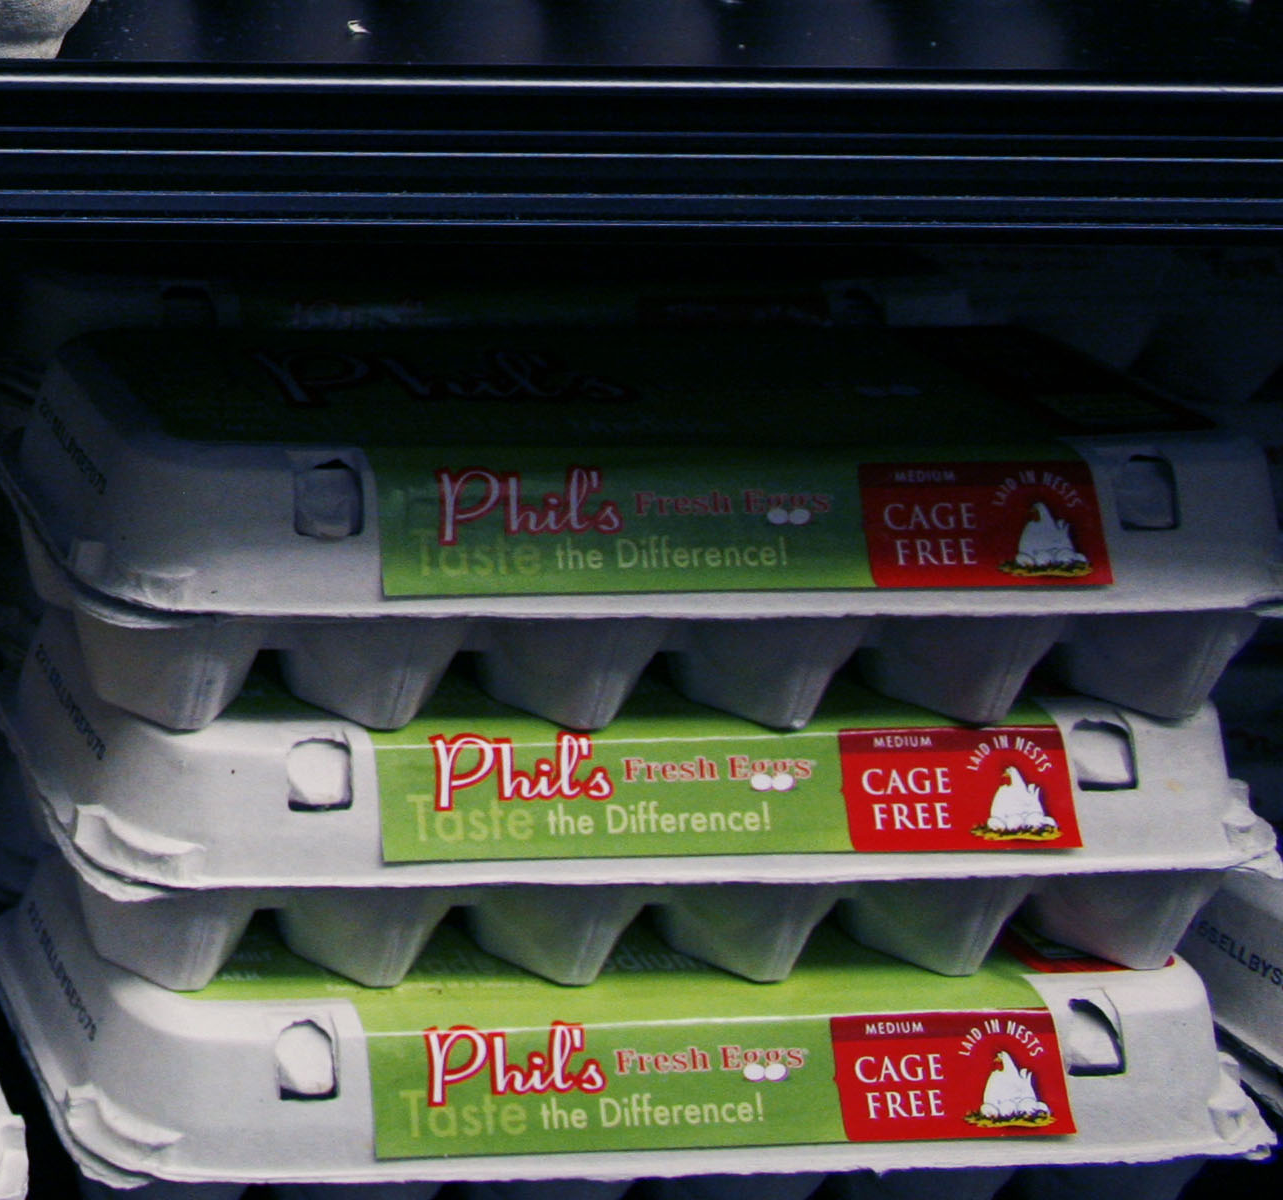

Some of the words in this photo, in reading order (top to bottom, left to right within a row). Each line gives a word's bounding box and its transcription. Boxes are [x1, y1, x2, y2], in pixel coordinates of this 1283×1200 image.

[423, 1019, 609, 1108] Phil's
[853, 1054, 946, 1084] CAGE
[865, 1090, 947, 1121] FREE
